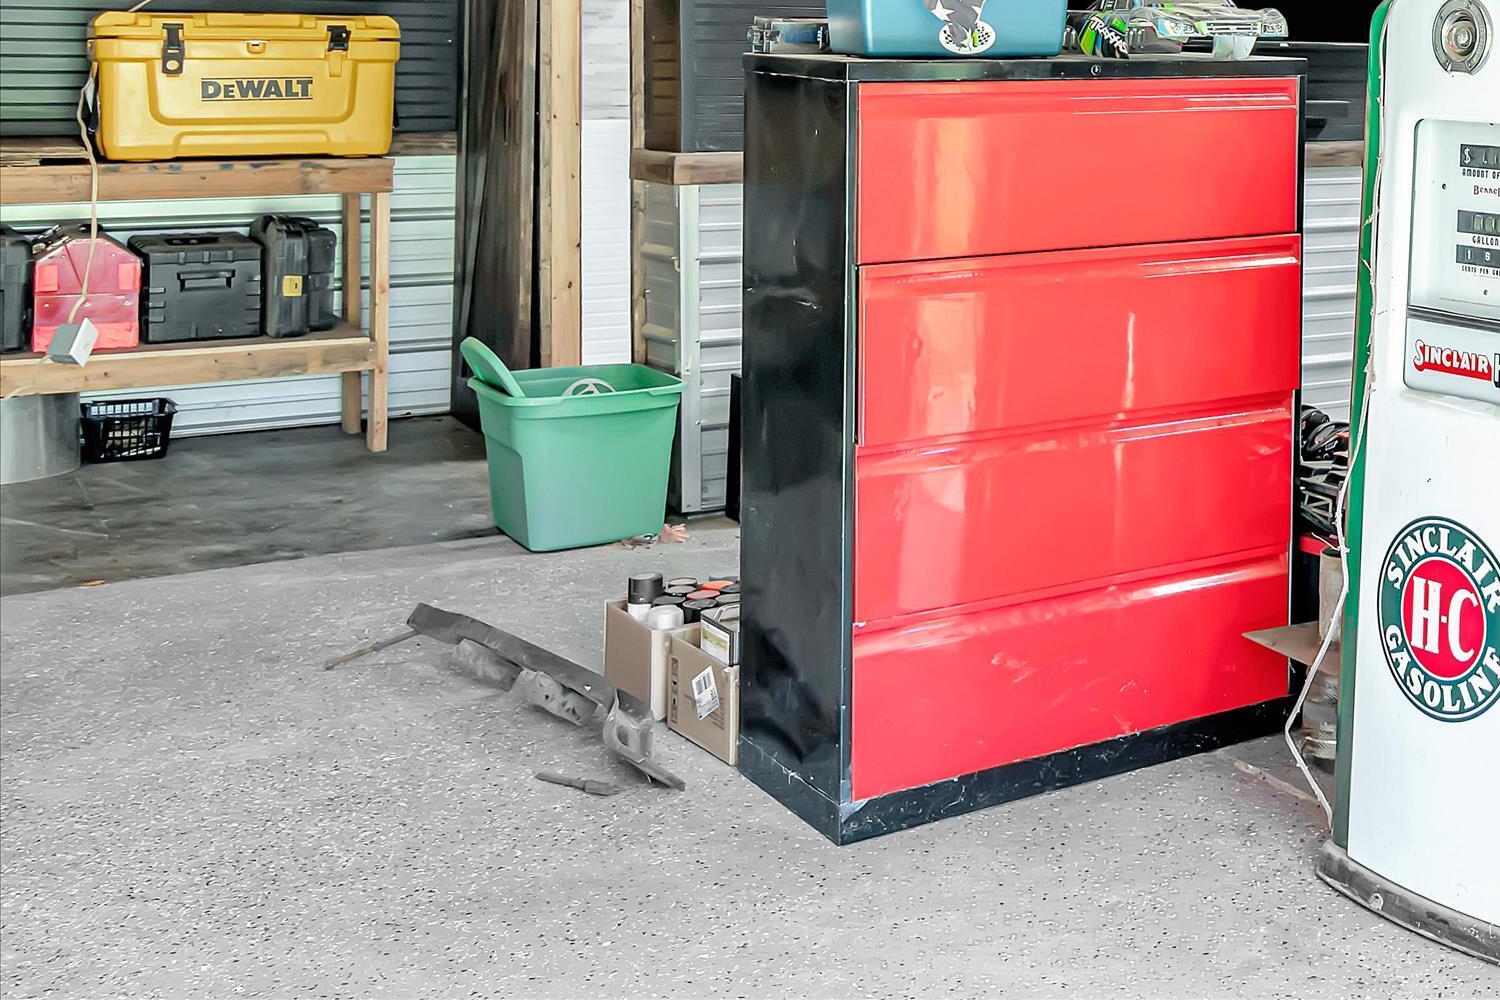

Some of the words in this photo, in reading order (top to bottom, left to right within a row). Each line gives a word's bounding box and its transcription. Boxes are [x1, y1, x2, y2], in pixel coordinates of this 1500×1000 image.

[201, 79, 313, 99] DEWALT
[1462, 168, 1488, 179] AMOUNT
[1492, 171, 1500, 180] OF
[1461, 265, 1477, 274] CENTS
[1479, 266, 1489, 275] PER
[1413, 339, 1489, 375] SINCLAIR
[1411, 575, 1478, 663] H-C
